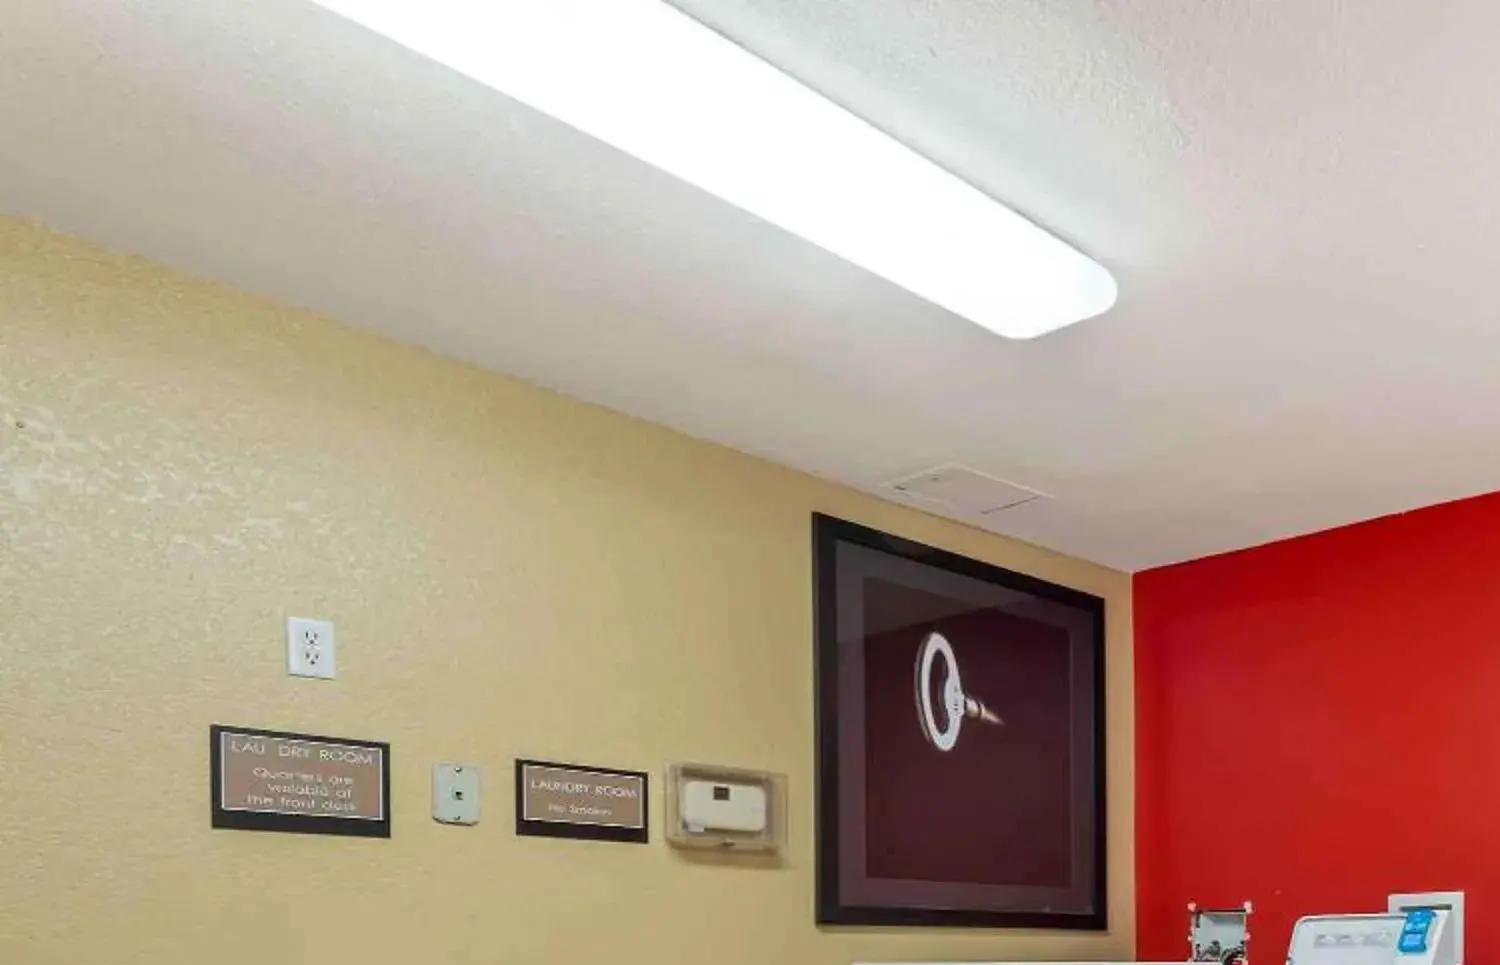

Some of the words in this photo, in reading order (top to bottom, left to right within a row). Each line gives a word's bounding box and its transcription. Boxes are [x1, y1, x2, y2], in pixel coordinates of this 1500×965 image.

[319, 749, 373, 765] ROOM
[531, 777, 590, 794] LAUNDRY
[595, 784, 638, 799] ROOM
[280, 796, 316, 810] front
